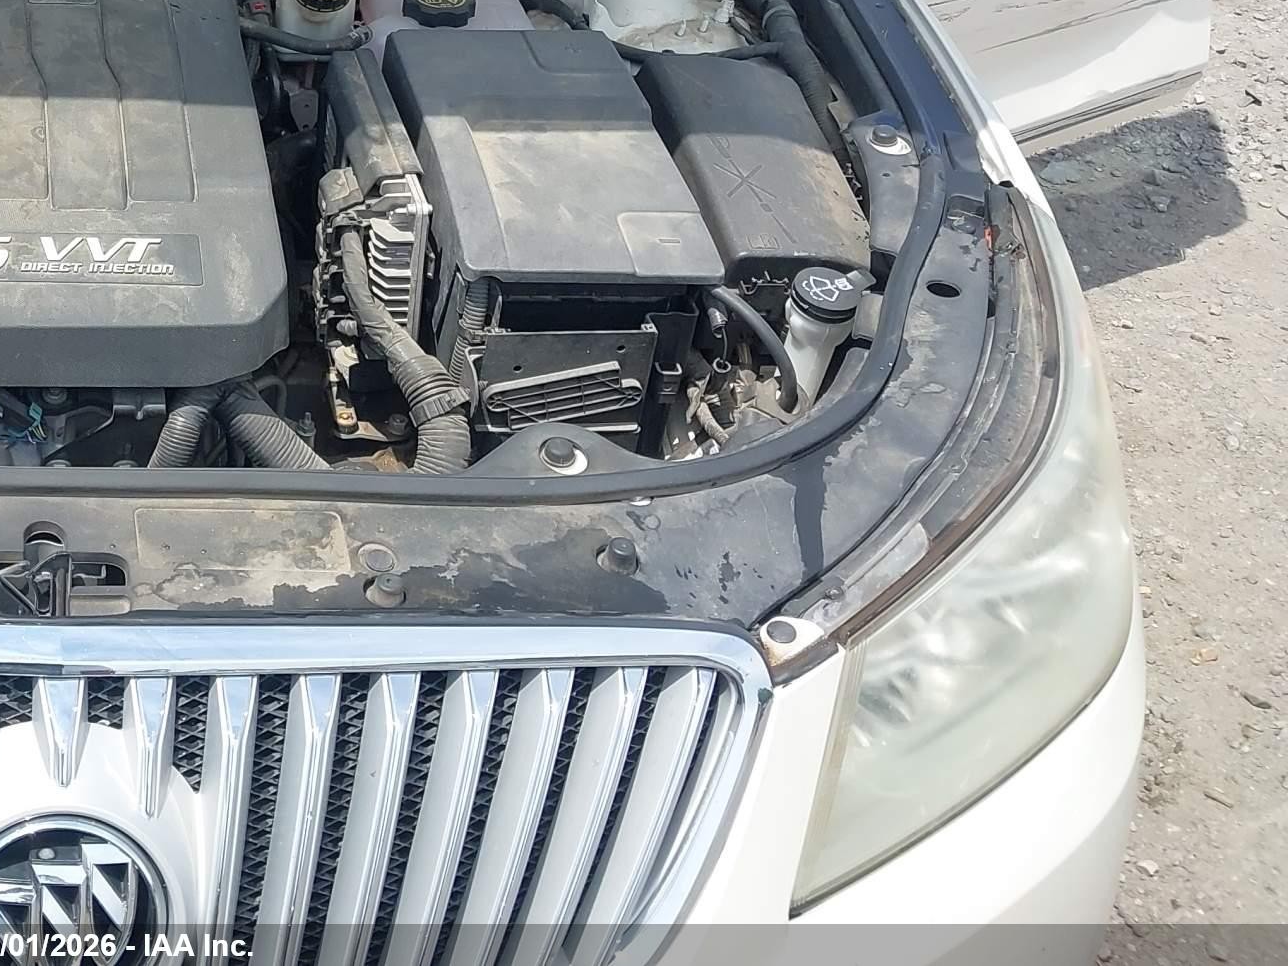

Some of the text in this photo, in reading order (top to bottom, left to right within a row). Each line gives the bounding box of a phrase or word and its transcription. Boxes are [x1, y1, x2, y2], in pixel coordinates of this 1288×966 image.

[40, 236, 162, 263] VVT
[21, 262, 174, 275] DIRECT INJECTION
